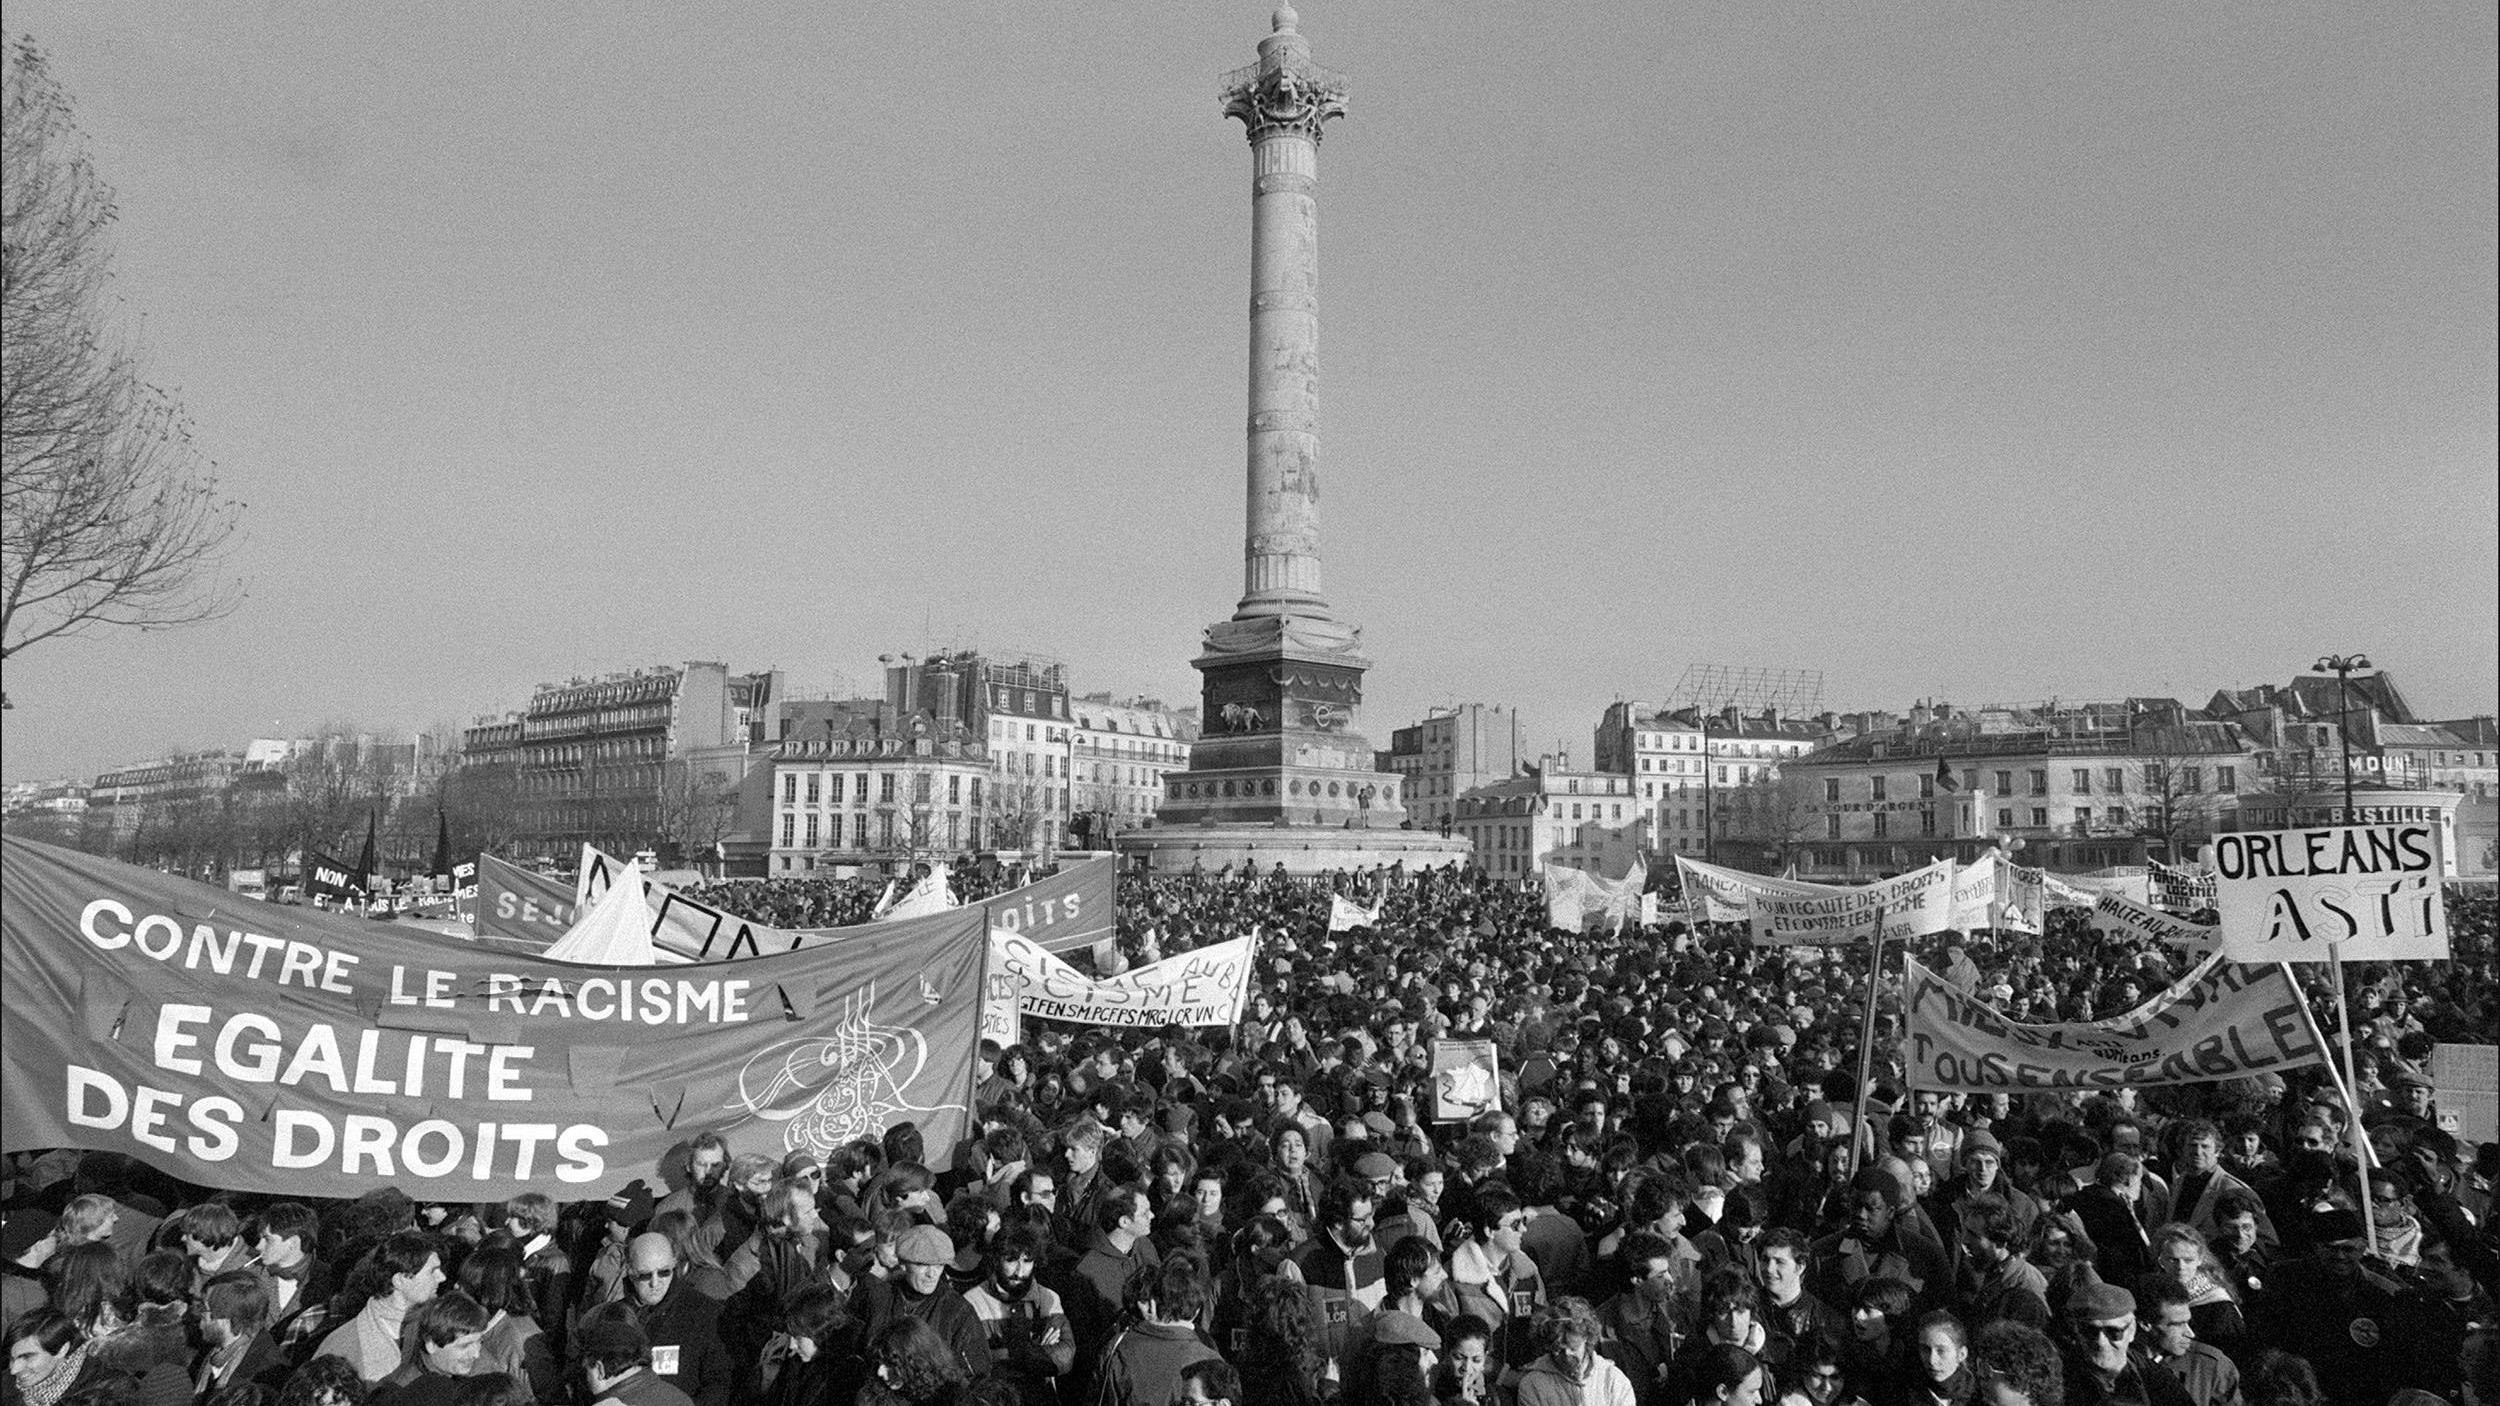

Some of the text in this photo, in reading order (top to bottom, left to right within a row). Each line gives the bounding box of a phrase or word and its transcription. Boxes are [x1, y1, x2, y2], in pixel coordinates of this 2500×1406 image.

[314, 866, 348, 888] NON
[2216, 827, 2432, 880] ORLEANS
[80, 898, 750, 1025] CONTRE LE RACISME
[154, 1003, 536, 1101] EGALITE
[1912, 1032, 2010, 1088] TOUS
[67, 1064, 609, 1183] DES DROITS
[1326, 1311, 1347, 1323] LCR
